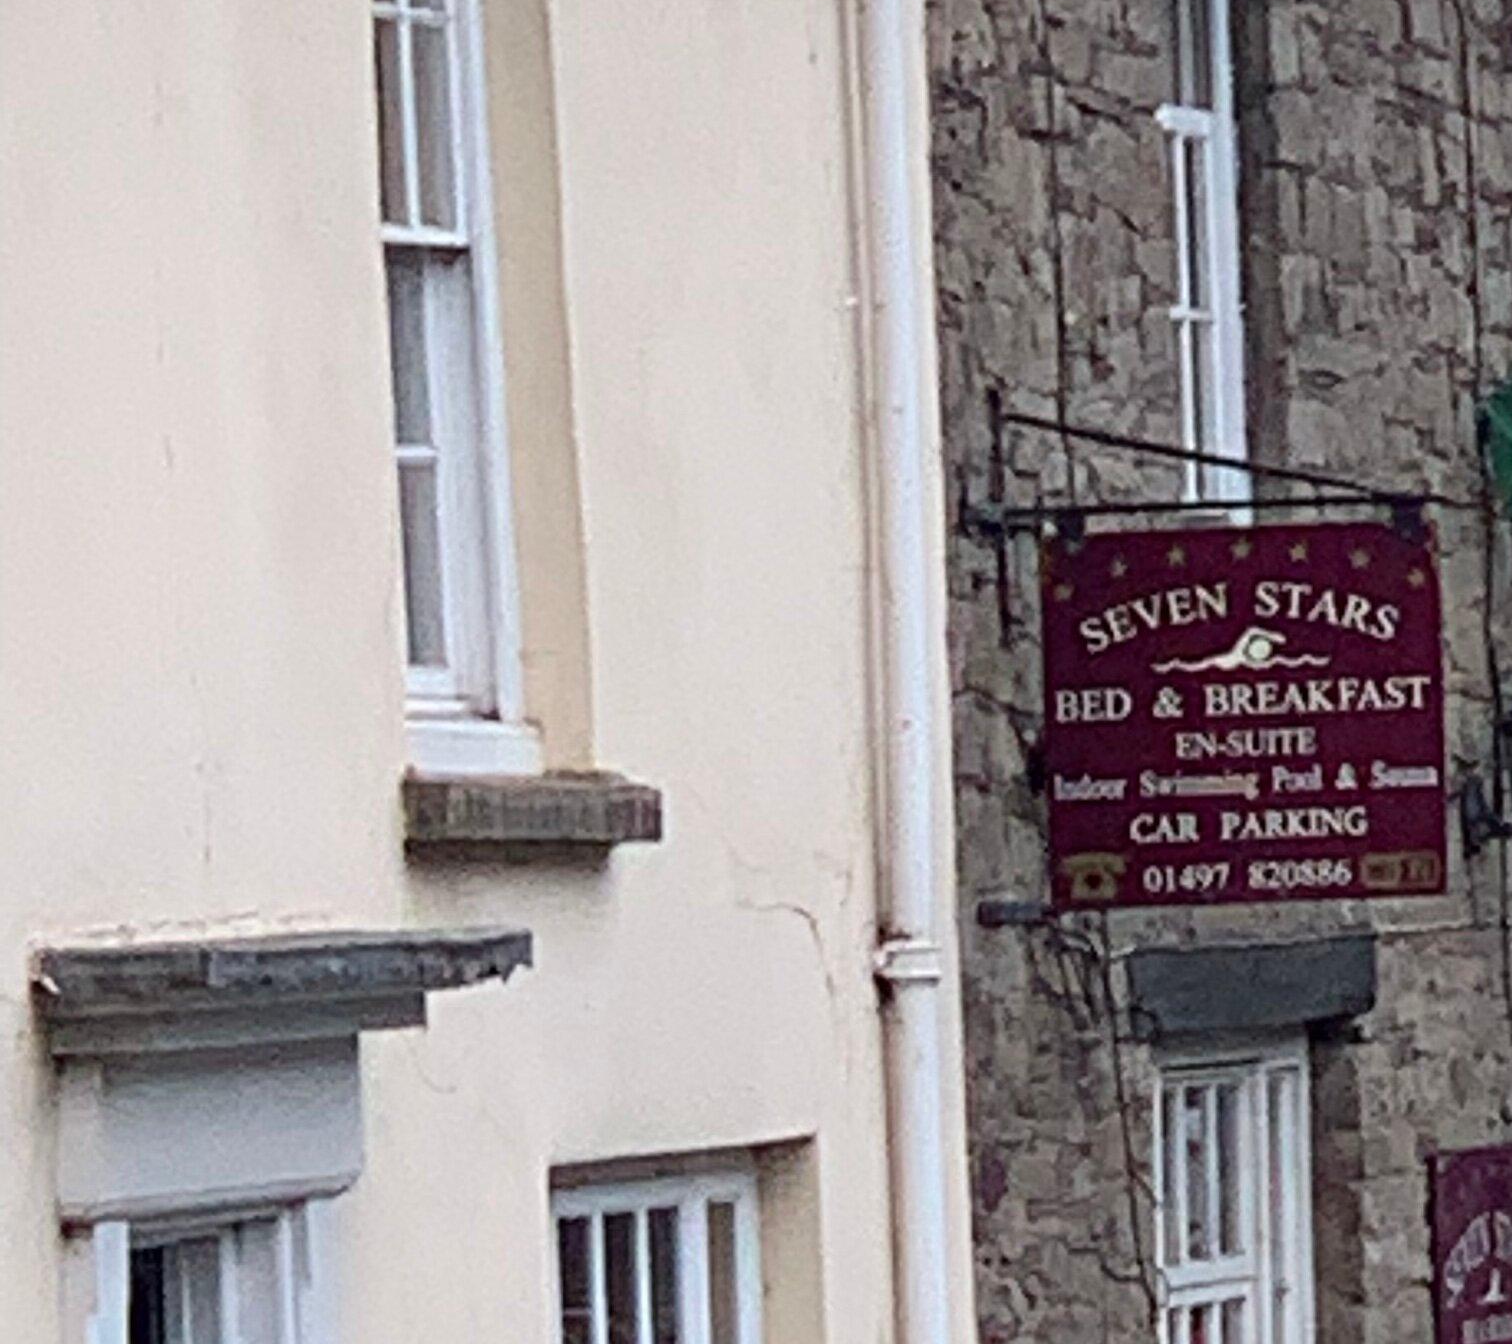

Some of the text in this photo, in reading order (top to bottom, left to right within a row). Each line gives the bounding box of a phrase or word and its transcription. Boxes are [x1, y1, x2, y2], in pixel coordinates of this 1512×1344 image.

[1079, 581, 1400, 654] SEVEN STARS
[1056, 676, 1432, 723] BED & BREAKFAST
[1175, 726, 1317, 760] EN-SUITE
[1053, 773, 1128, 801] Indoor
[1271, 762, 1323, 792] Pool
[1129, 806, 1368, 843] CAR PARKING
[1143, 862, 1230, 892] 01497
